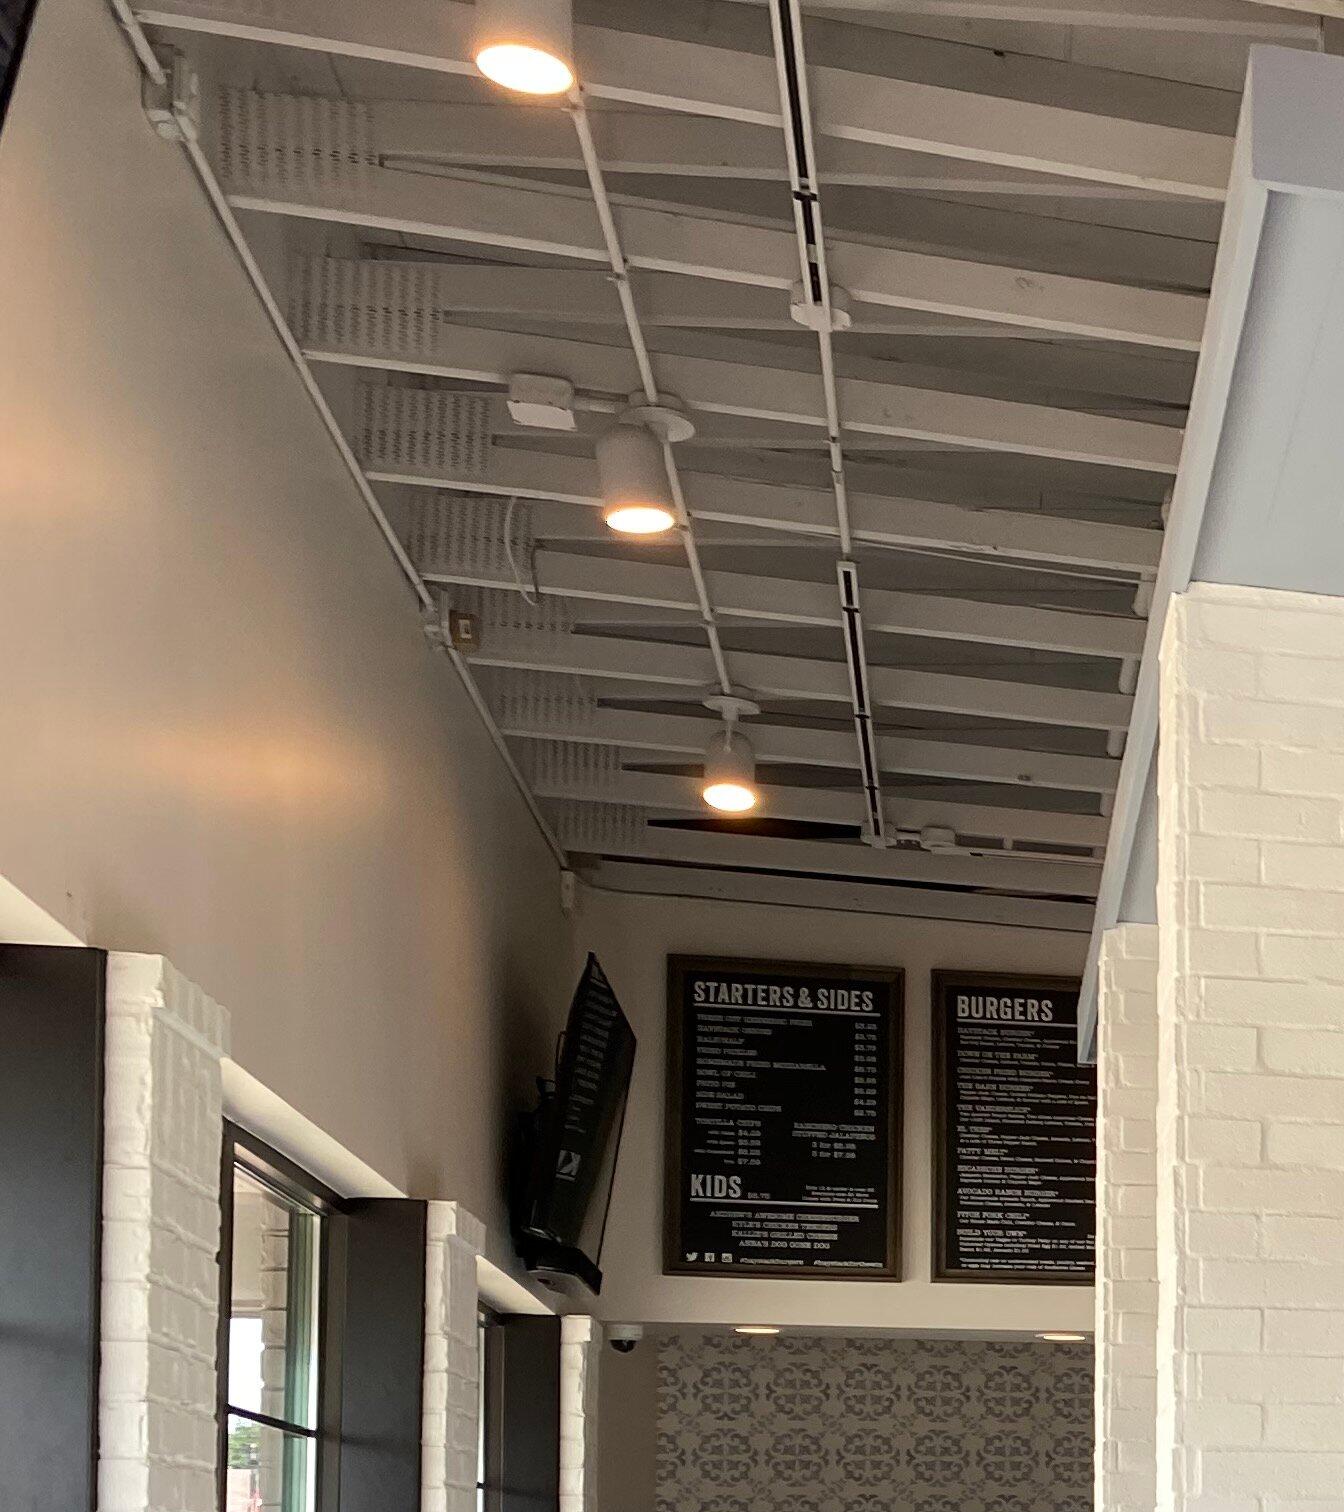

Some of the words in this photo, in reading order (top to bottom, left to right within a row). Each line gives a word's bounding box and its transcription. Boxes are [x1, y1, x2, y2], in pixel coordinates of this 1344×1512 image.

[694, 981, 794, 1007] STARTERS
[797, 988, 813, 1008] &
[817, 988, 874, 1012] SIDES
[957, 995, 1053, 1022] BURGERS
[690, 1174, 742, 1198] KIDS
